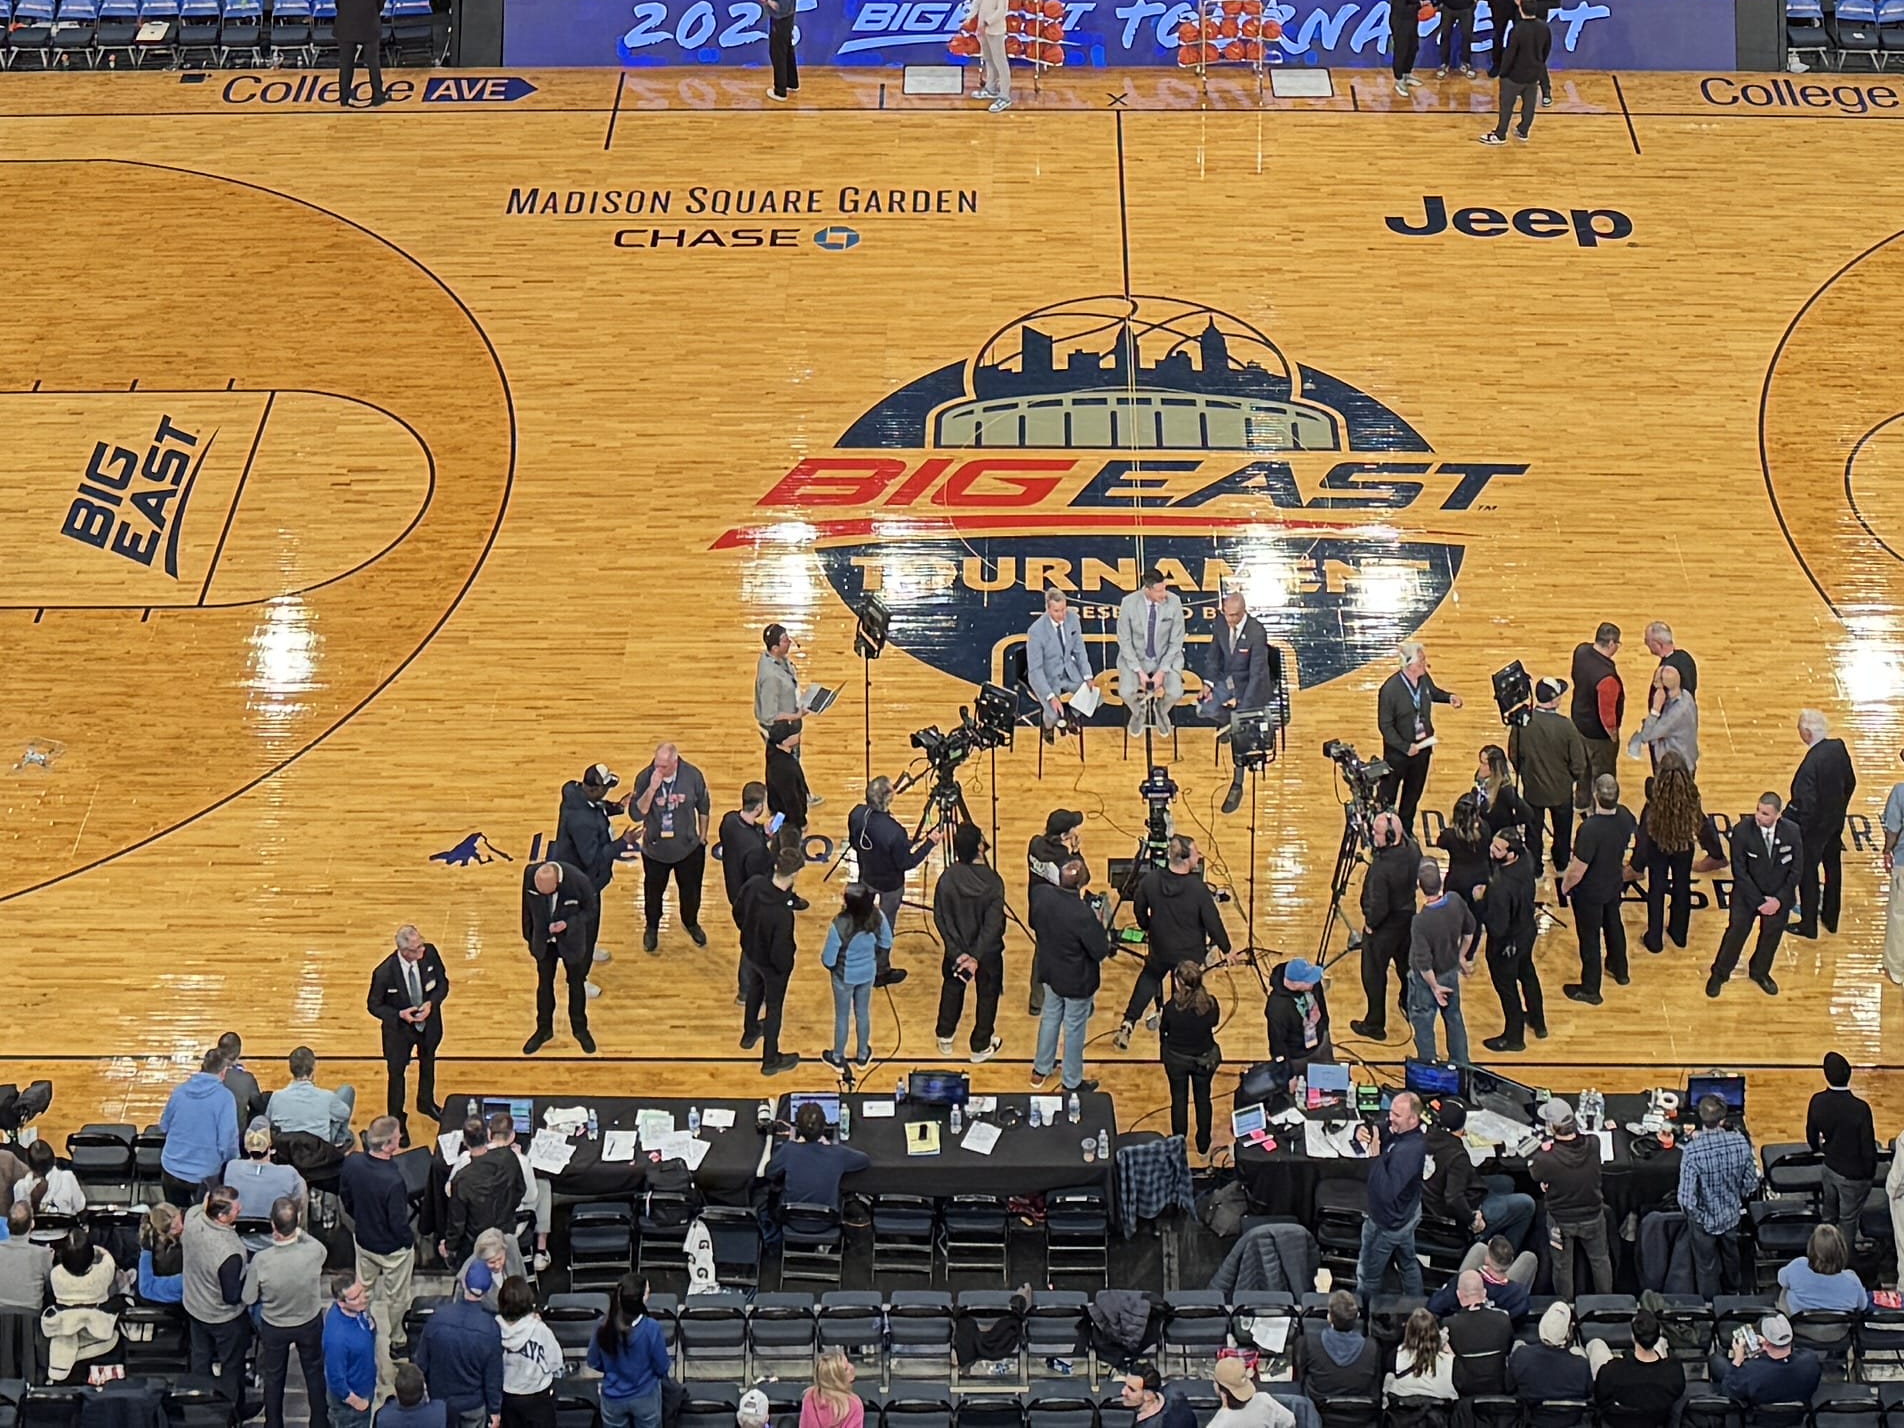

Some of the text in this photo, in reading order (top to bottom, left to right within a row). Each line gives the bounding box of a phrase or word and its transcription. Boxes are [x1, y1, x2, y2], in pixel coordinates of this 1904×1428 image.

[425, 77, 504, 102] AVE
[1699, 78, 1900, 121] College
[613, 225, 802, 249] CHASE
[1383, 195, 1634, 247] Jeep
[60, 440, 139, 550] BIG
[109, 414, 198, 567] EAST
[753, 456, 1530, 511] BIG EAST
